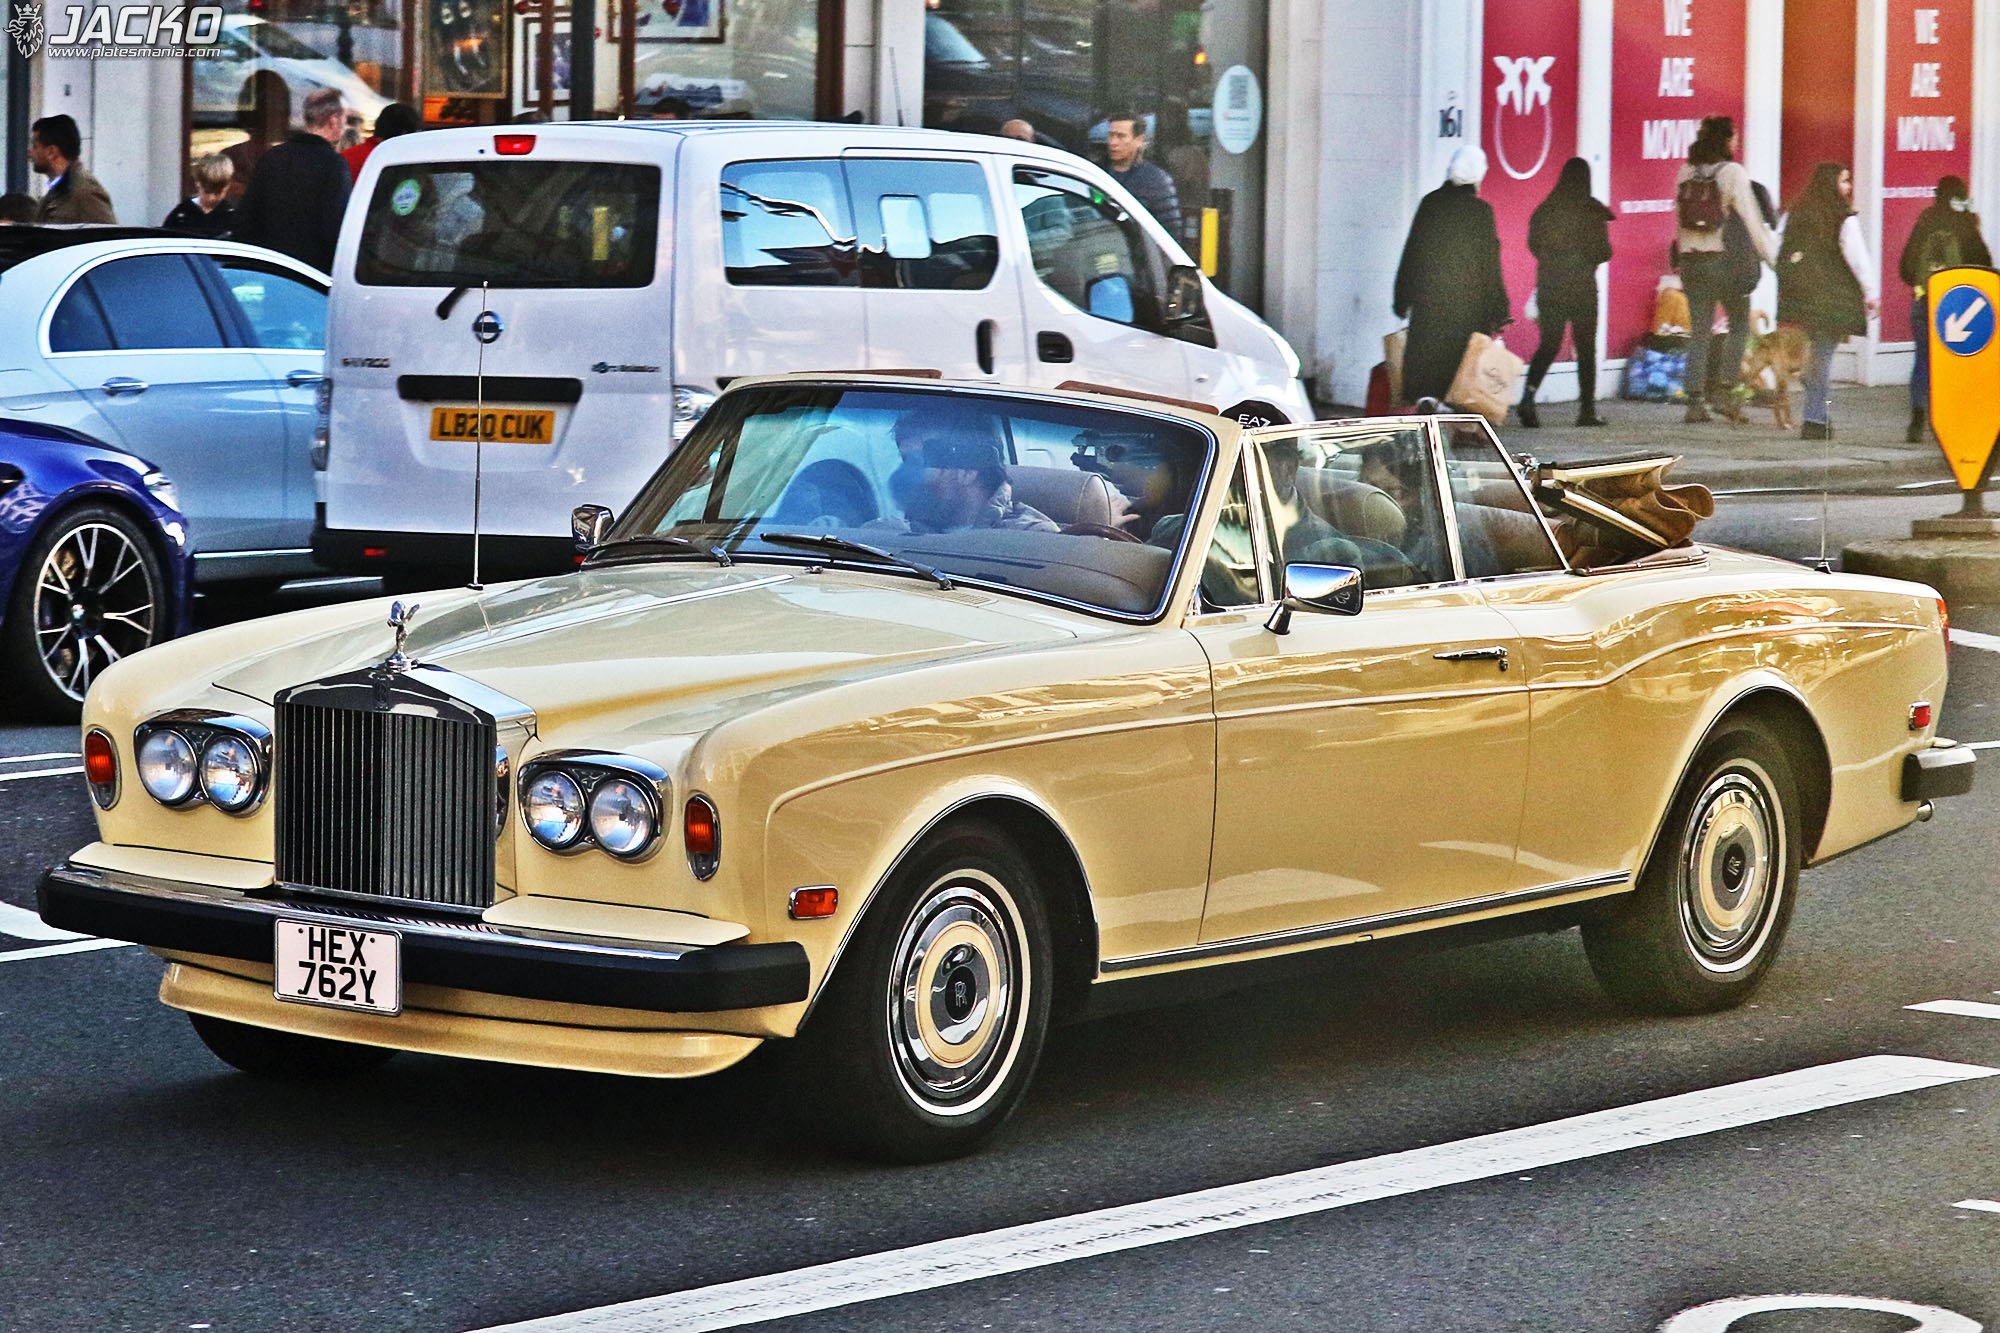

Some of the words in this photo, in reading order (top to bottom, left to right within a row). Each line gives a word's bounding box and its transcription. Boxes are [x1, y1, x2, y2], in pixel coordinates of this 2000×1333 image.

[1664, 0, 1693, 36] WE
[1915, 9, 1940, 44] WE
[1658, 57, 1695, 97] ARE
[1910, 62, 1942, 97] ARE
[1438, 105, 1462, 138] 161
[1897, 116, 1956, 151] MOVING
[438, 412, 496, 439] LB20
[501, 413, 545, 440] CUK
[1238, 413, 1271, 428] EA7
[308, 926, 367, 967] HEX
[298, 960, 377, 1004] 762Y
